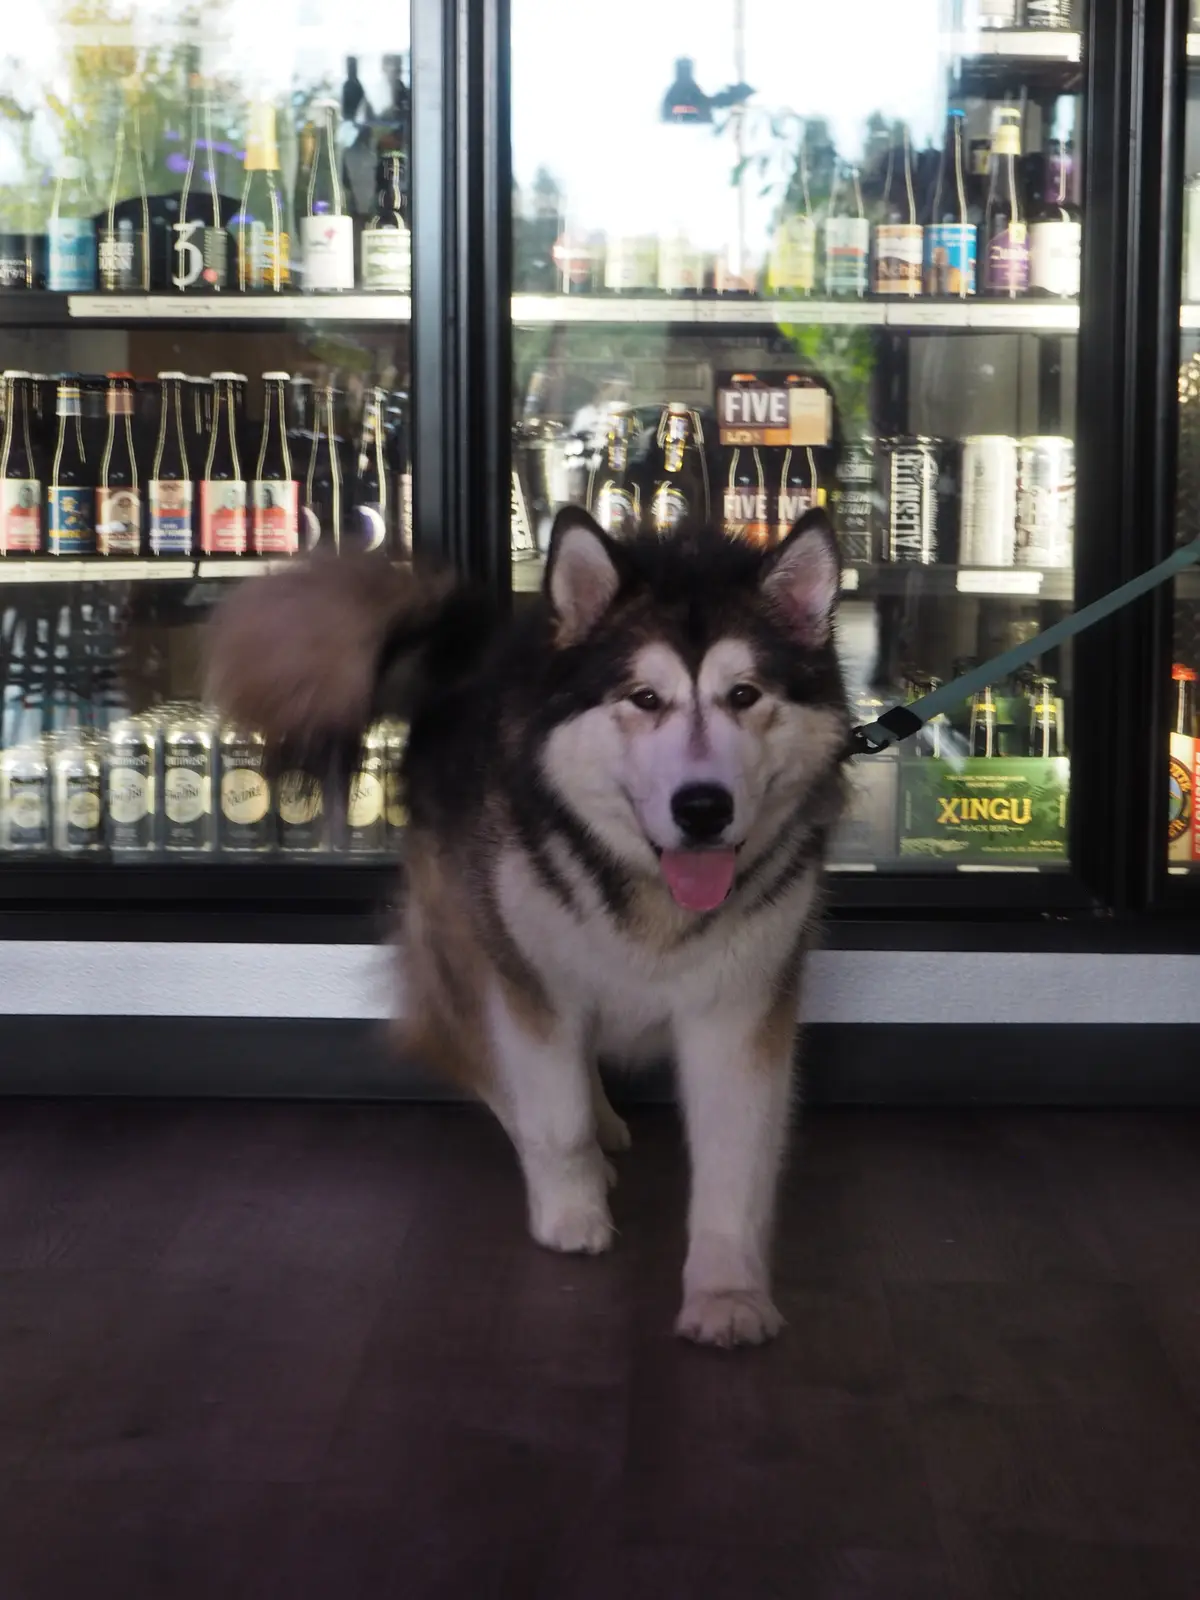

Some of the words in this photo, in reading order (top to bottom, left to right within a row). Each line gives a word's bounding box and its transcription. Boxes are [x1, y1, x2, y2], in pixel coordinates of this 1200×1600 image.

[724, 391, 788, 424] FIVE
[723, 494, 768, 521] FIVE
[892, 452, 923, 549] ALESMITH
[936, 797, 1033, 825] XINGU
